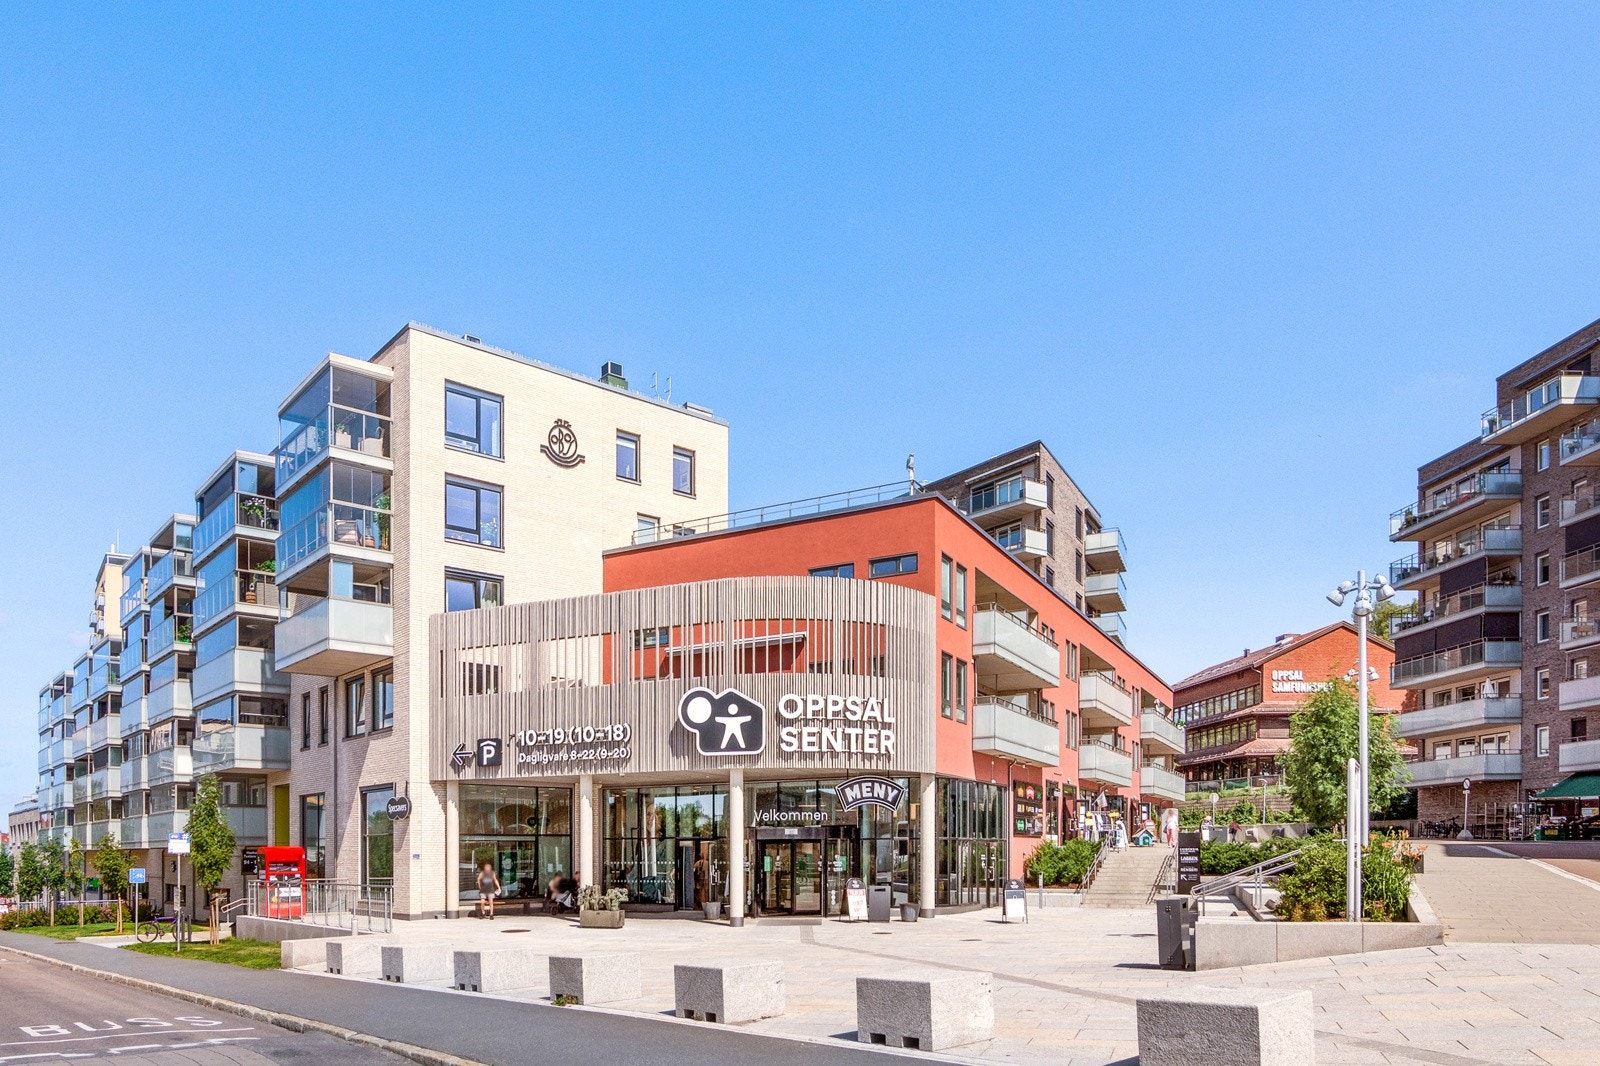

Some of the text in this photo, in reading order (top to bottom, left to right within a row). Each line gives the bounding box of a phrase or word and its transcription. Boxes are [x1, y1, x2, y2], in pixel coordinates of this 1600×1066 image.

[1271, 669, 1304, 681] OPPSAL
[778, 693, 895, 723] OPPSAL
[779, 726, 895, 755] SENTER
[518, 751, 569, 765] Dagligvare
[844, 781, 899, 803] MENY
[754, 809, 829, 822] Velkommen
[19, 1016, 224, 1037] BUSS
